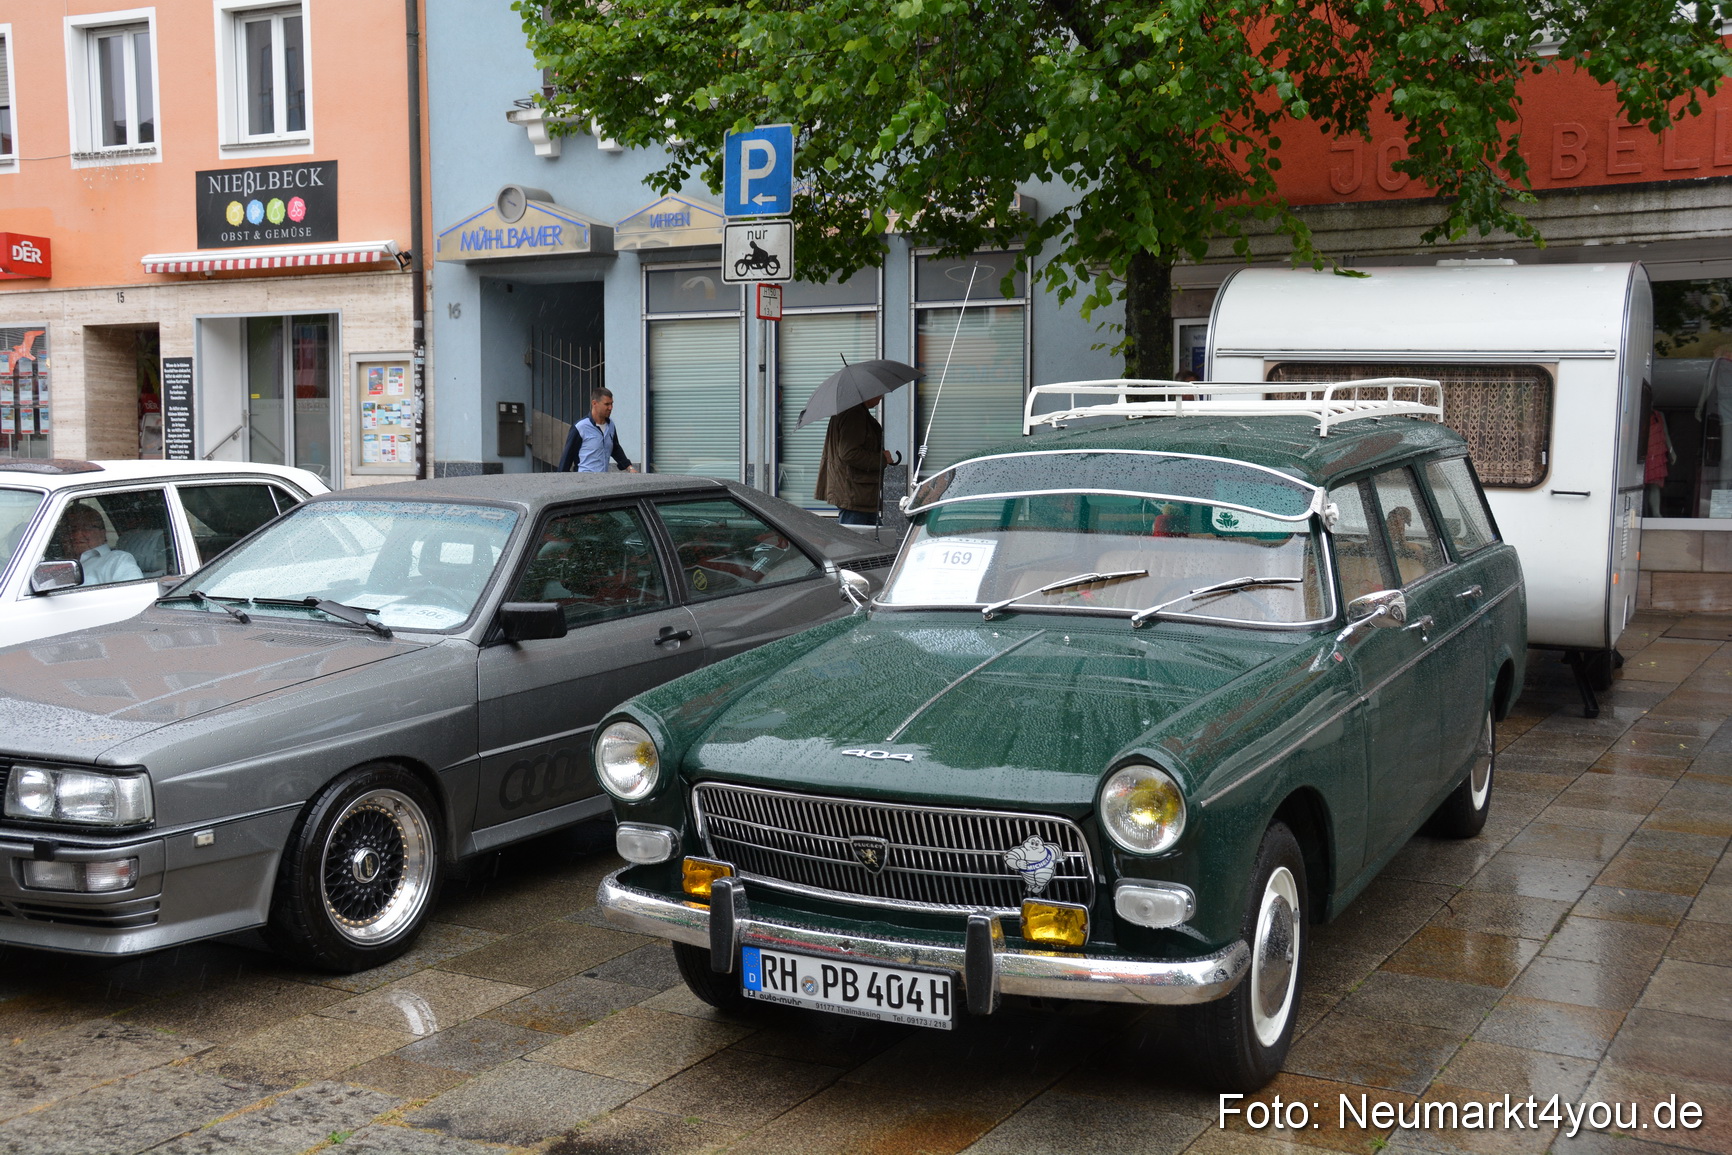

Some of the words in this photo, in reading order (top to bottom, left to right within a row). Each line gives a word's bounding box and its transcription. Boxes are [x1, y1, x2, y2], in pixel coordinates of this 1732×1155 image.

[739, 138, 777, 205] P
[649, 211, 691, 229] UHREN
[221, 231, 250, 242] OBST
[253, 230, 261, 240] &
[265, 226, 312, 239] GEMÜSE
[460, 225, 564, 252] MÜHLBAUER
[747, 229, 768, 240] nur
[12, 243, 43, 264] DER
[116, 291, 125, 304] 15
[448, 302, 462, 319] 16
[942, 550, 973, 565] 169
[841, 749, 914, 762] 404
[749, 972, 756, 983] D
[761, 954, 797, 993] RH
[821, 964, 860, 1002] PB
[815, 1002, 835, 1011] 91177
[934, 1020, 947, 1029] 218
